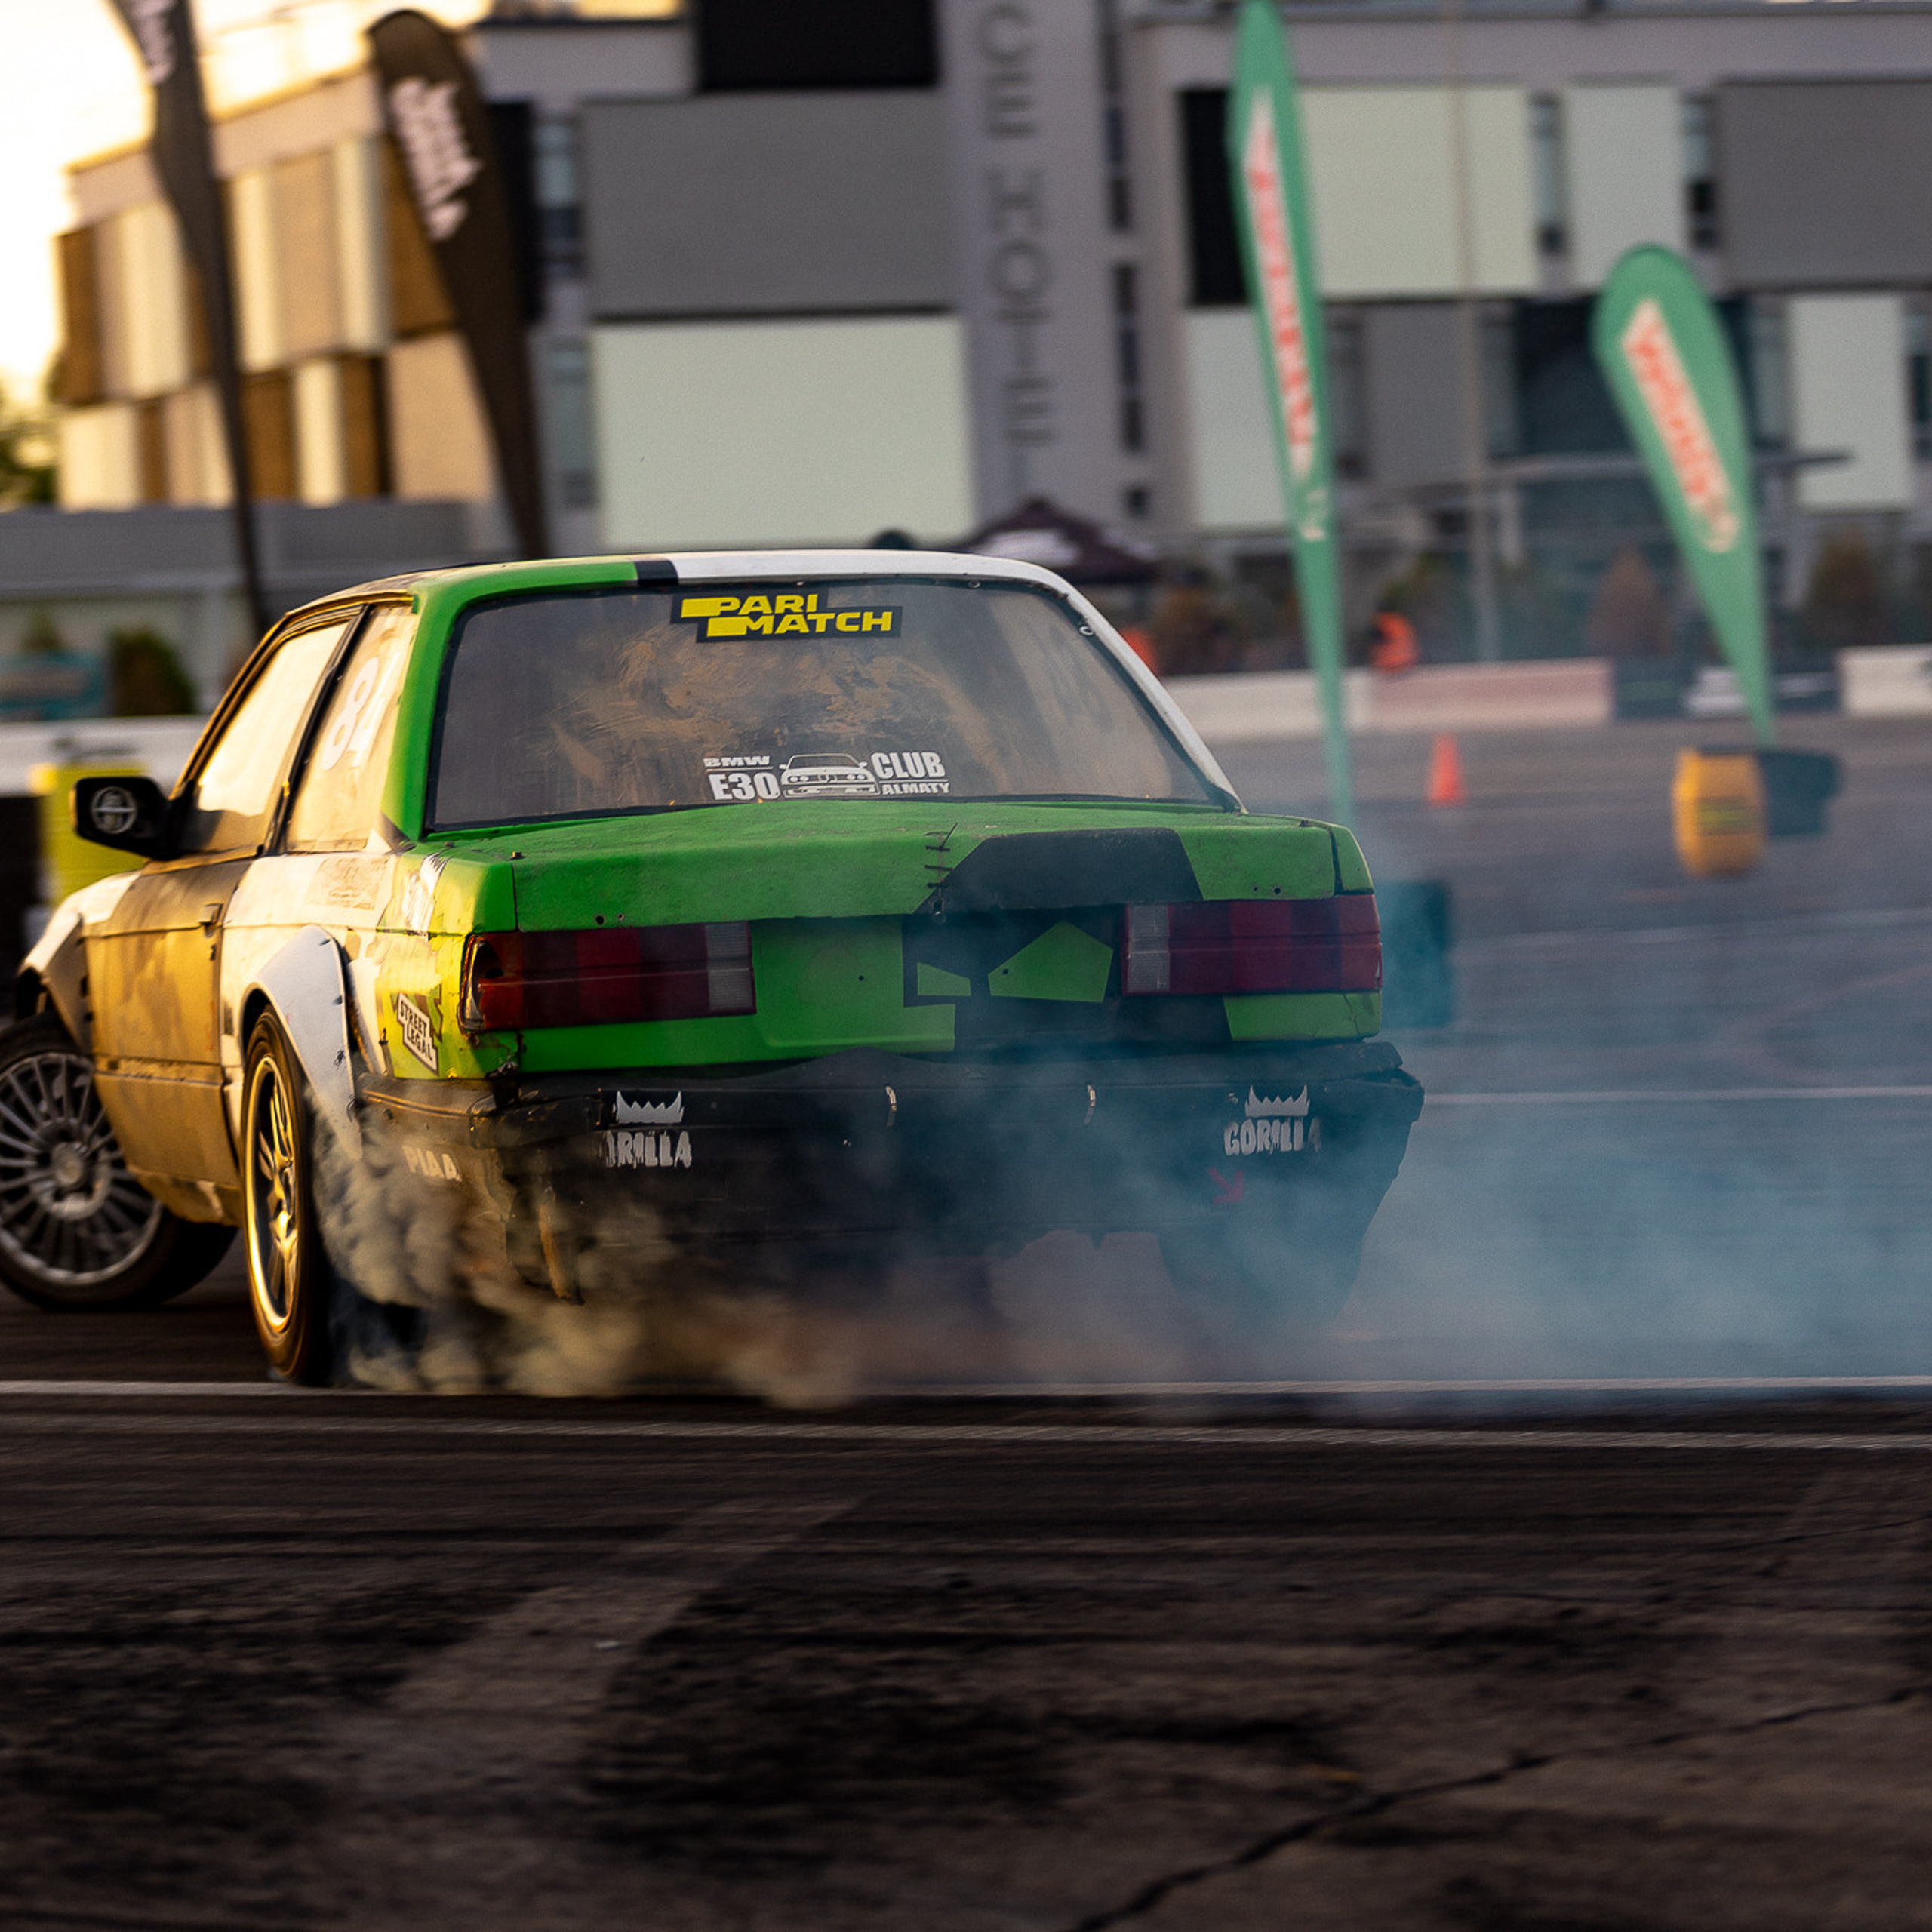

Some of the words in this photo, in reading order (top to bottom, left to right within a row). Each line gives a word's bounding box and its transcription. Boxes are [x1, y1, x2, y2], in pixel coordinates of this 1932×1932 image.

[681, 594, 818, 618] PARI
[706, 611, 893, 637] MATCH
[703, 755, 771, 768] BMW
[870, 751, 946, 779] CLUB
[708, 772, 781, 801] E30
[881, 782, 950, 796] ALMATY
[399, 998, 428, 1038] STREET
[406, 1023, 434, 1062] LEGAL
[1223, 1116, 1321, 1156] GORILLA
